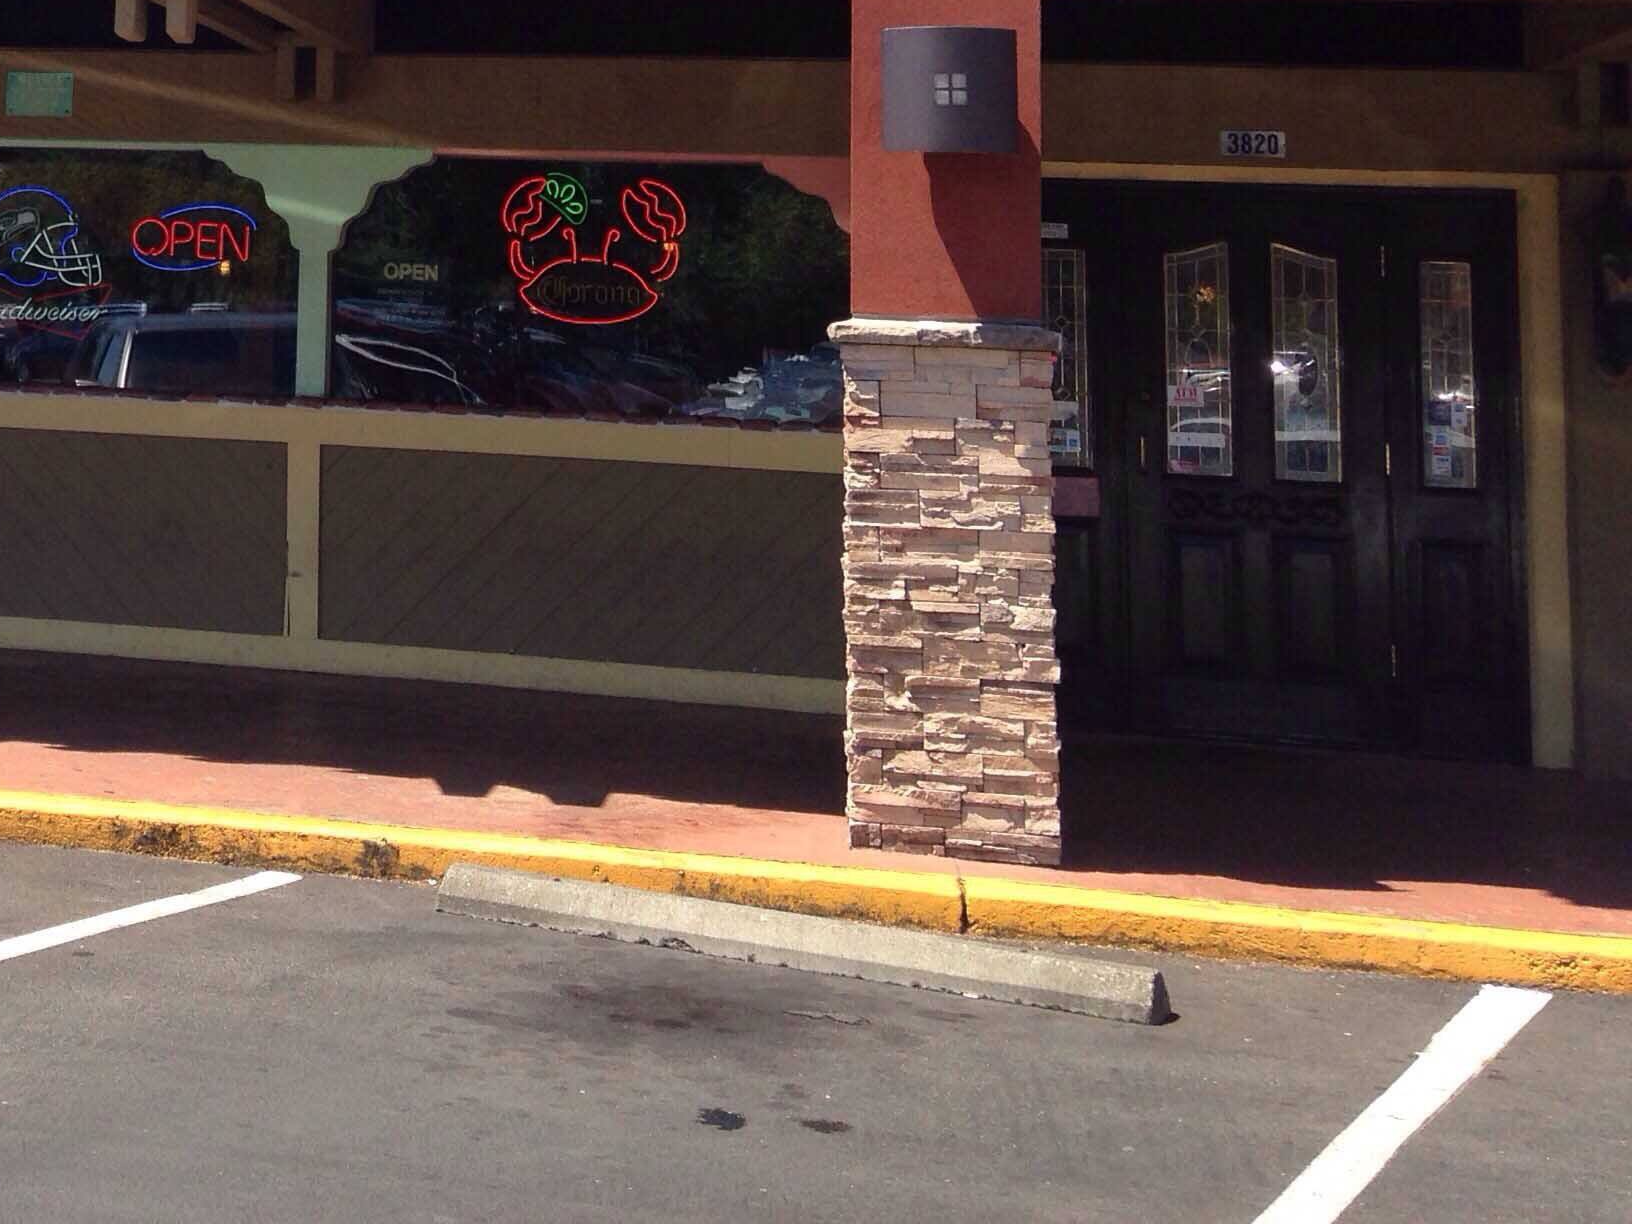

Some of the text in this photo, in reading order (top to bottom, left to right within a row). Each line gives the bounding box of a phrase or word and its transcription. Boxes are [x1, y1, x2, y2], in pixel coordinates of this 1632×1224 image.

[1226, 132, 1279, 155] 3820
[130, 215, 250, 263] OPEN
[383, 262, 439, 281] OPEN
[536, 274, 641, 307] Corona
